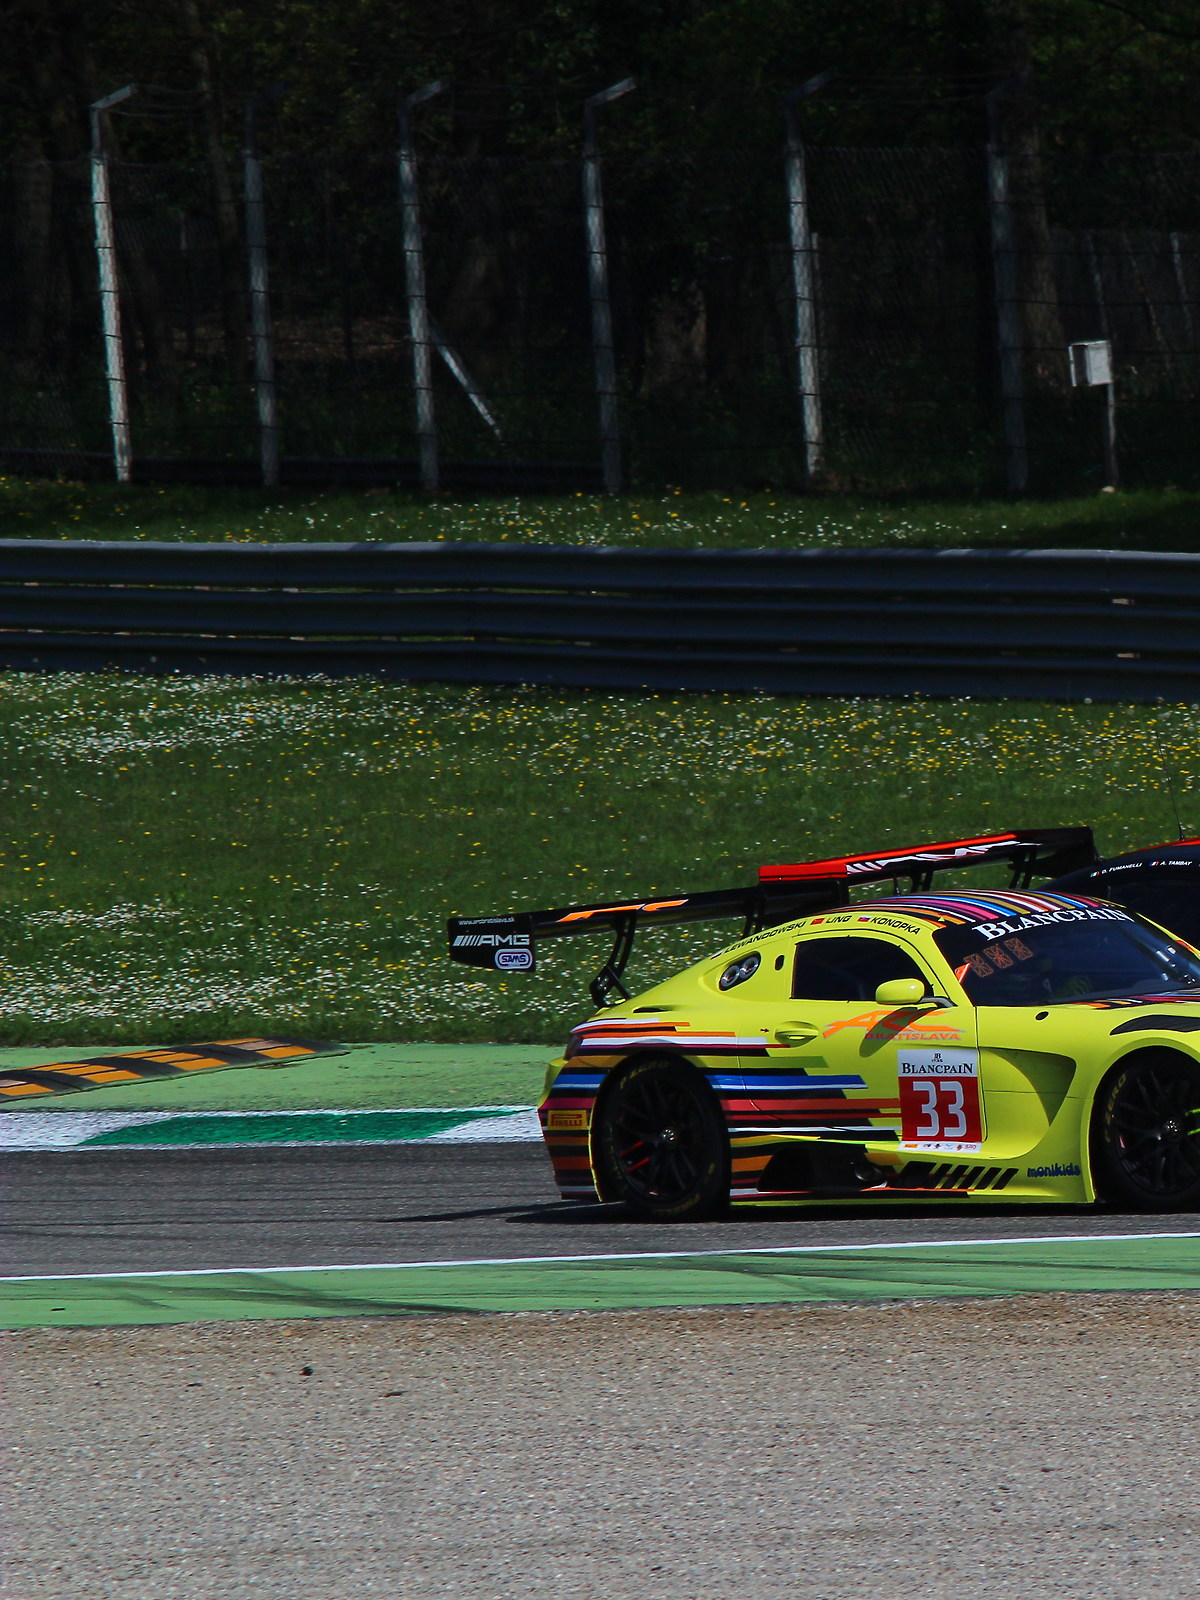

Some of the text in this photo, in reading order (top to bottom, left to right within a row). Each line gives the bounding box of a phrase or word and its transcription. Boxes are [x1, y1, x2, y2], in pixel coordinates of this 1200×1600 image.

[826, 915, 853, 924] LING
[870, 916, 921, 936] KONOPKA
[972, 907, 1134, 941] BLANCPAIN
[724, 920, 807, 954] LEWANDOWSKI
[501, 954, 527, 963] SAMS
[864, 1033, 962, 1041] BRATISLAVA
[902, 1062, 973, 1074] BLANCPAIN
[912, 1080, 968, 1138] 33
[1027, 1162, 1081, 1178] monikids
